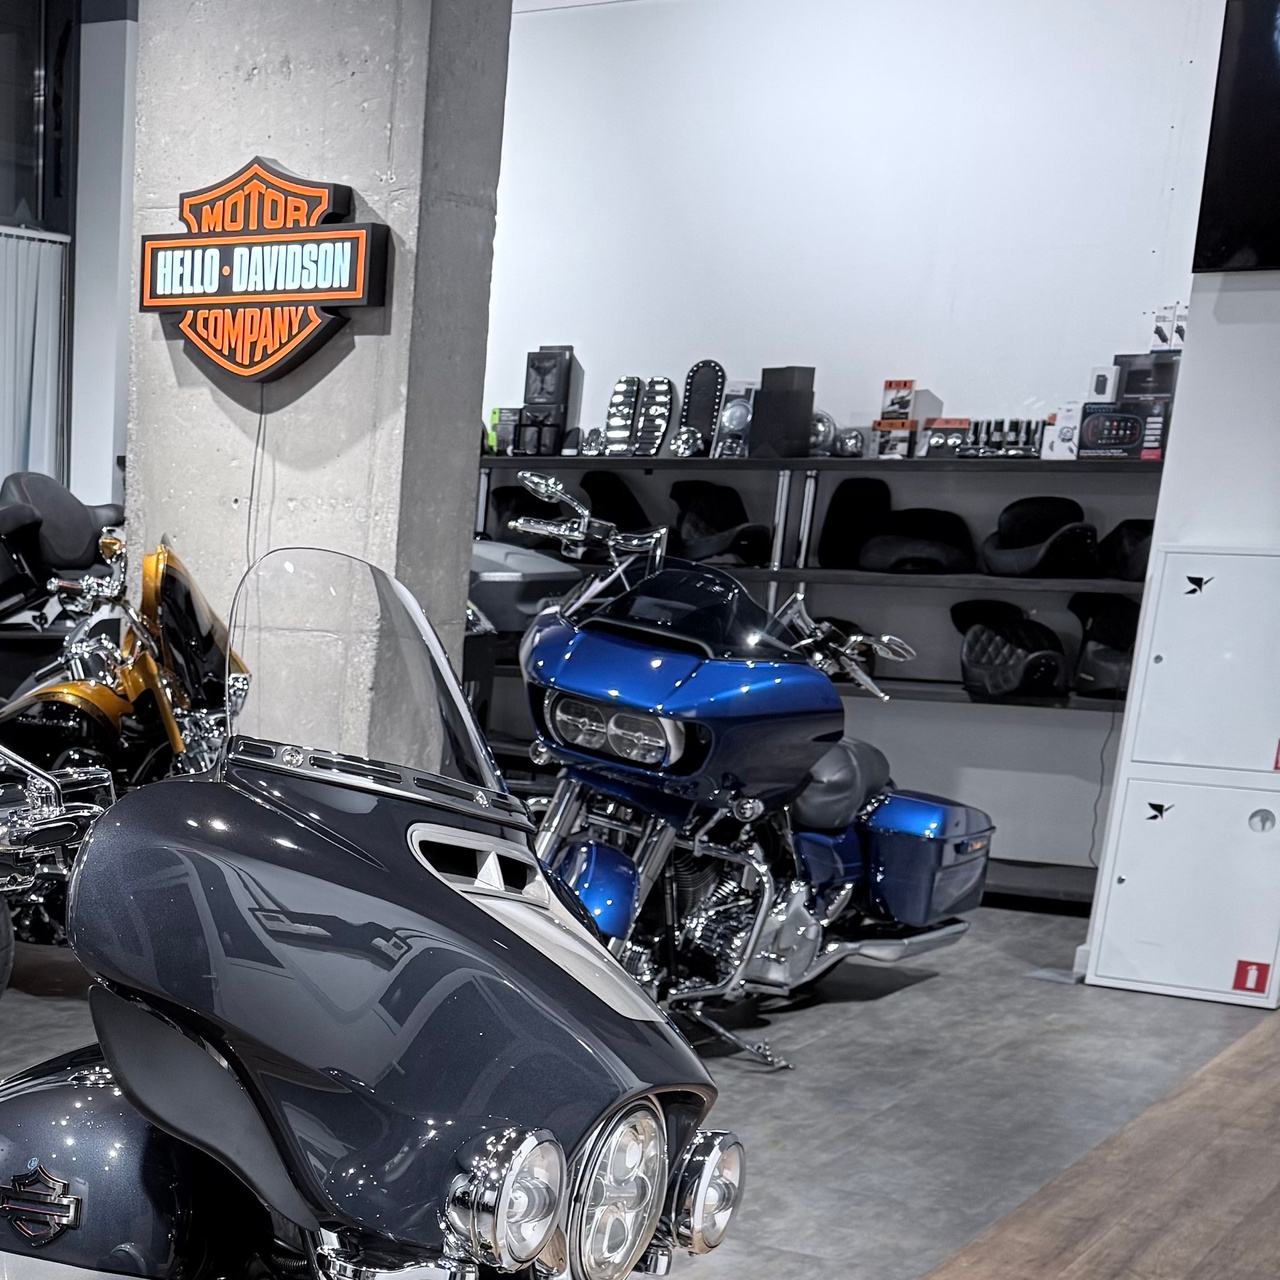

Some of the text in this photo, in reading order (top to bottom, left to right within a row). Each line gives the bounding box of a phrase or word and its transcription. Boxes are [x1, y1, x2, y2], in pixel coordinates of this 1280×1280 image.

[201, 179, 308, 233] MOTOR
[156, 242, 352, 295] HELLO DAVIDSON
[196, 306, 305, 365] COMPANY
